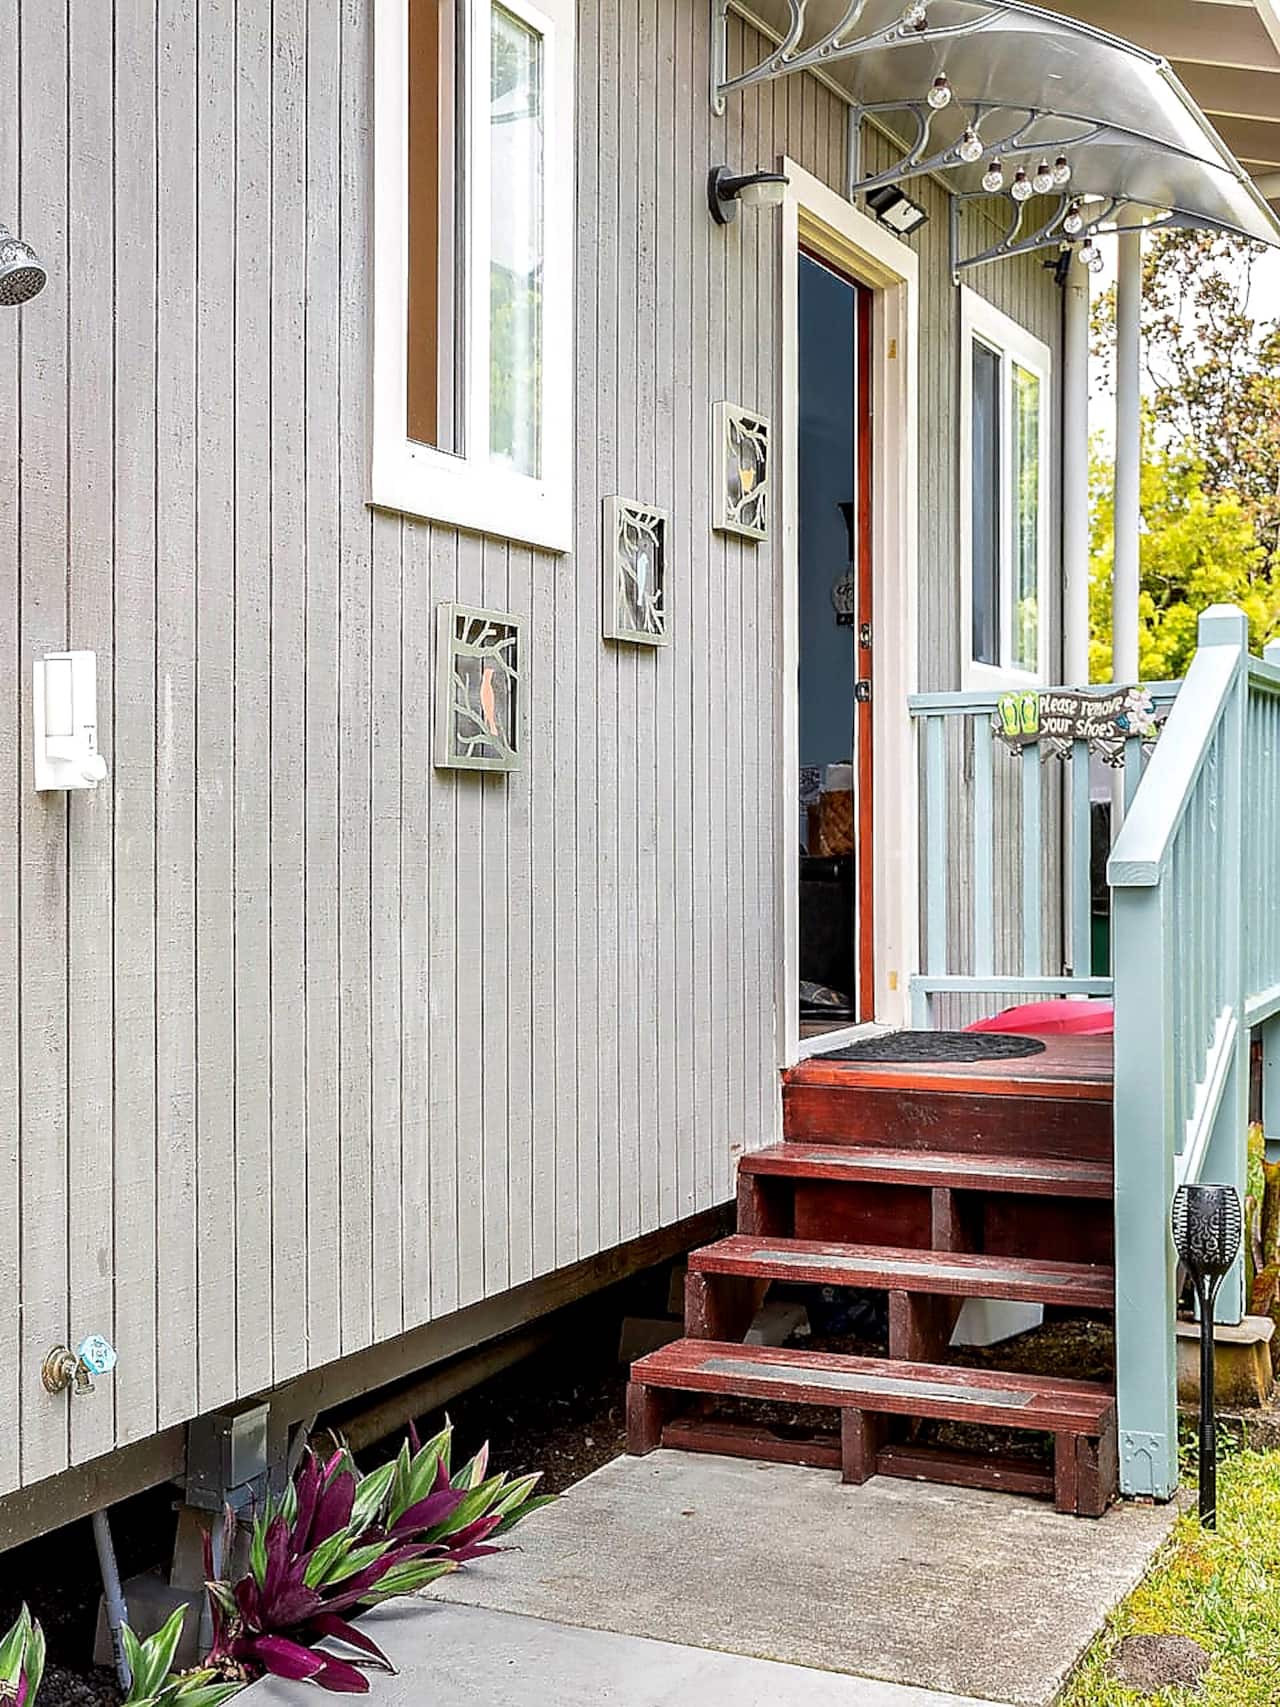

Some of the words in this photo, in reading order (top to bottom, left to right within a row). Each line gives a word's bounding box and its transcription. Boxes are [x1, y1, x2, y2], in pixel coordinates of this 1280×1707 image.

[1039, 694, 1078, 716] Please
[1081, 695, 1123, 717] remove
[1040, 717, 1073, 735] your
[1076, 716, 1117, 737] shoes
